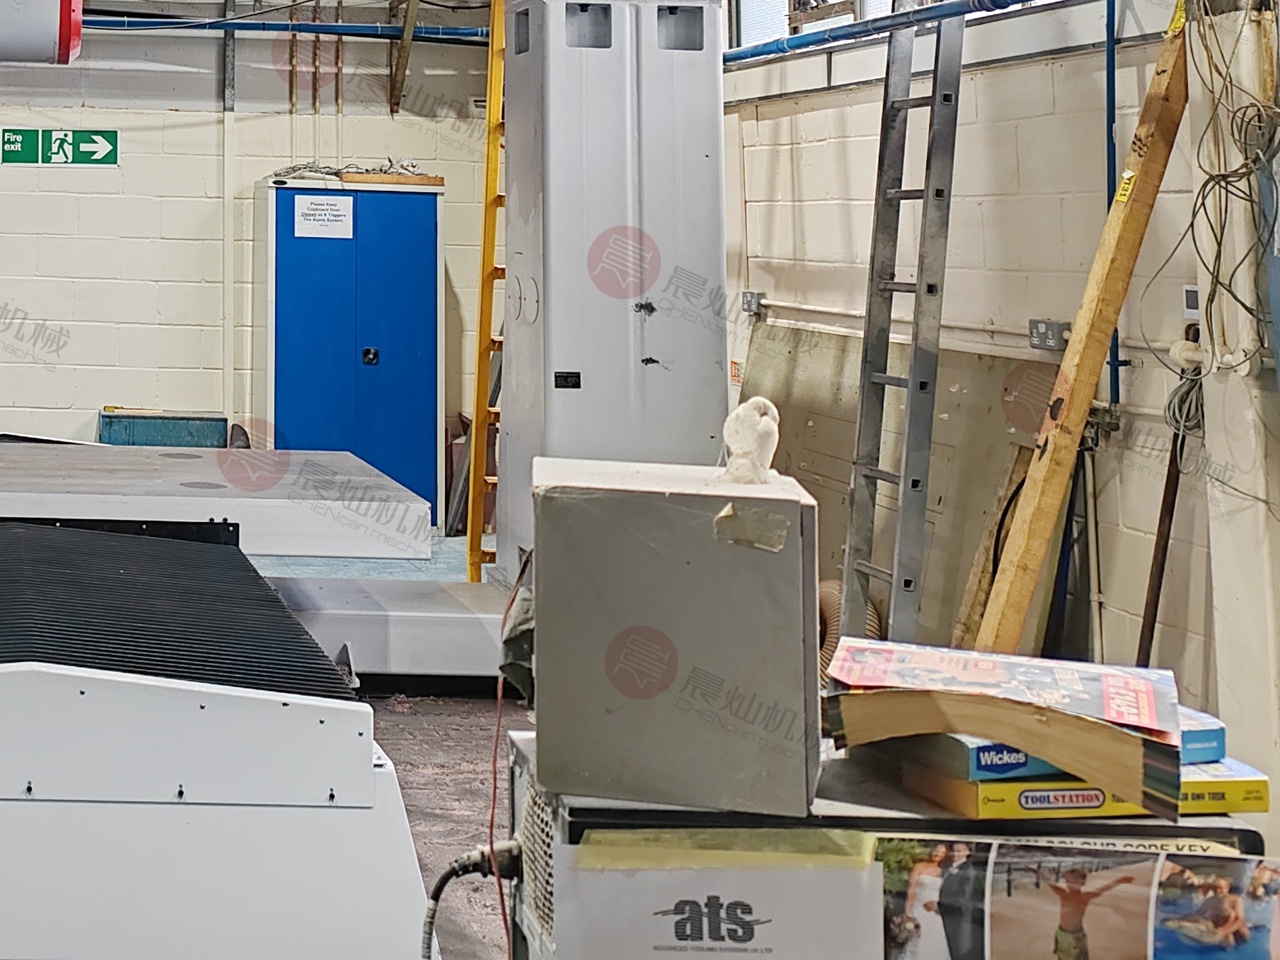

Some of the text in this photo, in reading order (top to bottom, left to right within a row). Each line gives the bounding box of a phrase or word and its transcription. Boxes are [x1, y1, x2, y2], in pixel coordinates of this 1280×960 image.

[4, 132, 23, 142] Fire
[4, 142, 22, 151] exit
[980, 750, 1026, 766] Wickes
[1023, 792, 1102, 806] TOOLSTATION
[673, 895, 755, 944] ats
